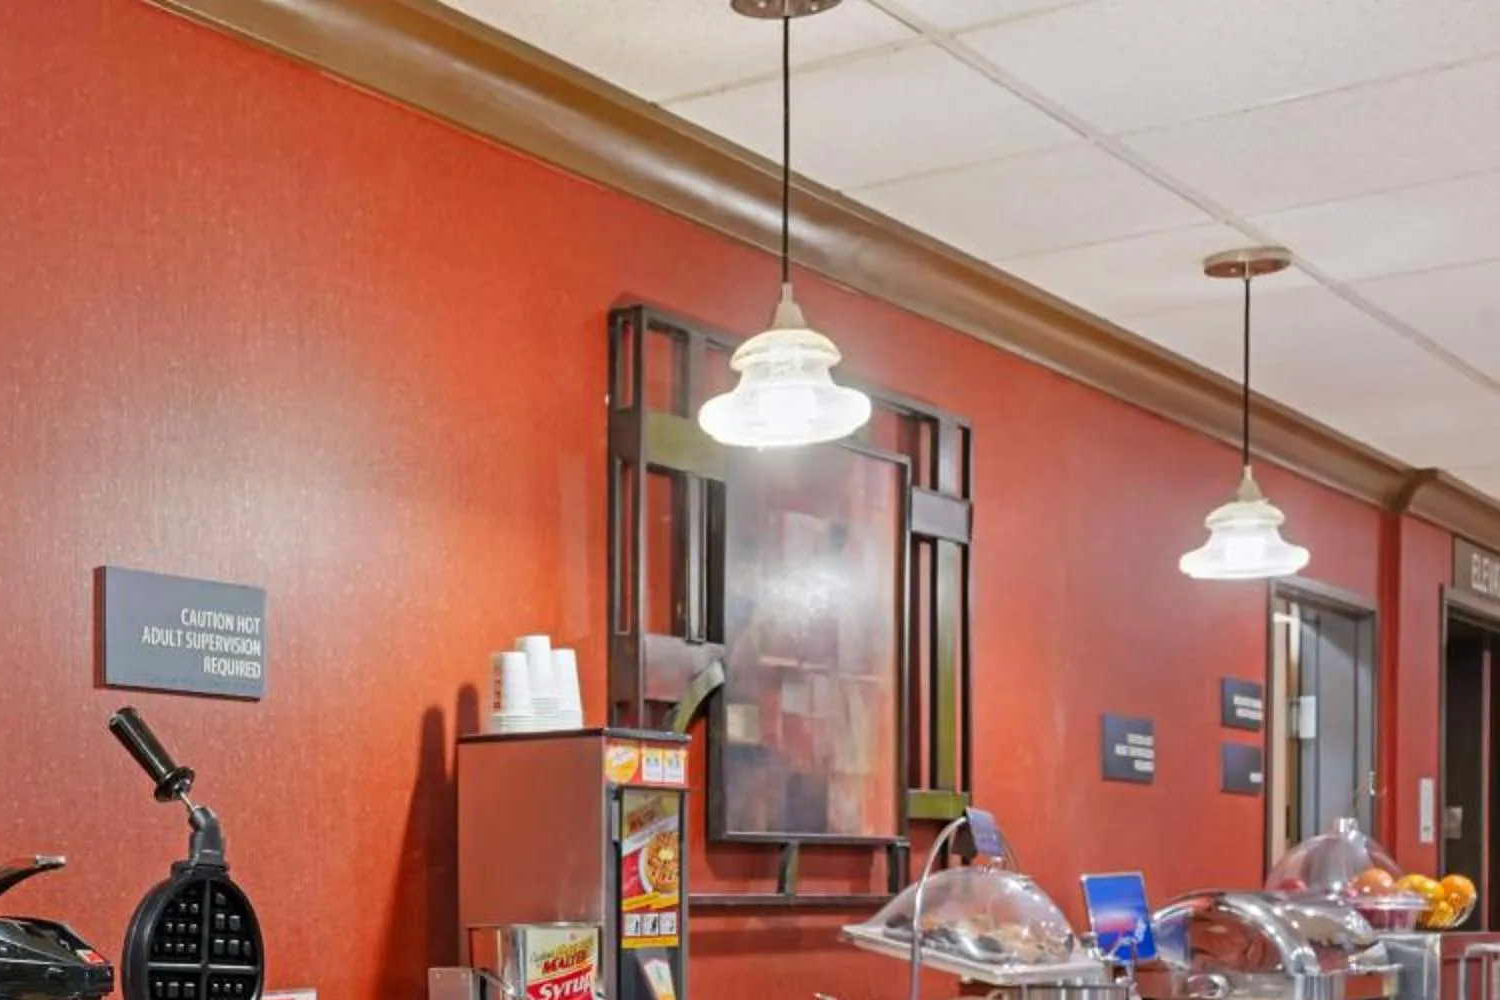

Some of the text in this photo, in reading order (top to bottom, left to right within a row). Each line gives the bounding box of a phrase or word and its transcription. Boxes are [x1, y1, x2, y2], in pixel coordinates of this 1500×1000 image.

[181, 608, 261, 635] CAUTION HOT
[141, 625, 261, 657] ADULT SUPERVISION
[203, 655, 261, 679] REQUIRED
